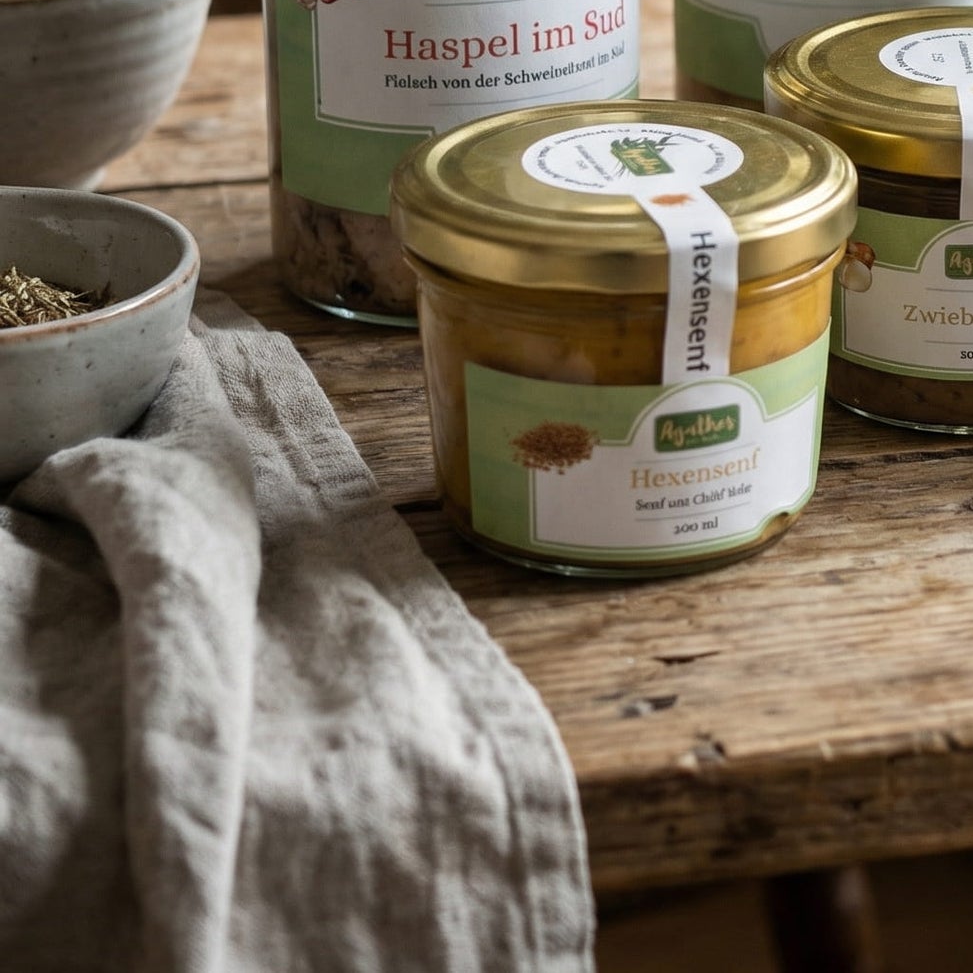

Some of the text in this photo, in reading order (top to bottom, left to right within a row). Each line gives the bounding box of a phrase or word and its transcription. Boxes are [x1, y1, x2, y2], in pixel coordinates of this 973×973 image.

[384, 23, 520, 69] Haspel
[532, 22, 576, 53] im
[442, 77, 471, 89] von
[474, 73, 501, 88] der
[686, 232, 717, 372] Hexensenf
[630, 448, 762, 489] Hexensenf
[702, 516, 718, 530] ml
